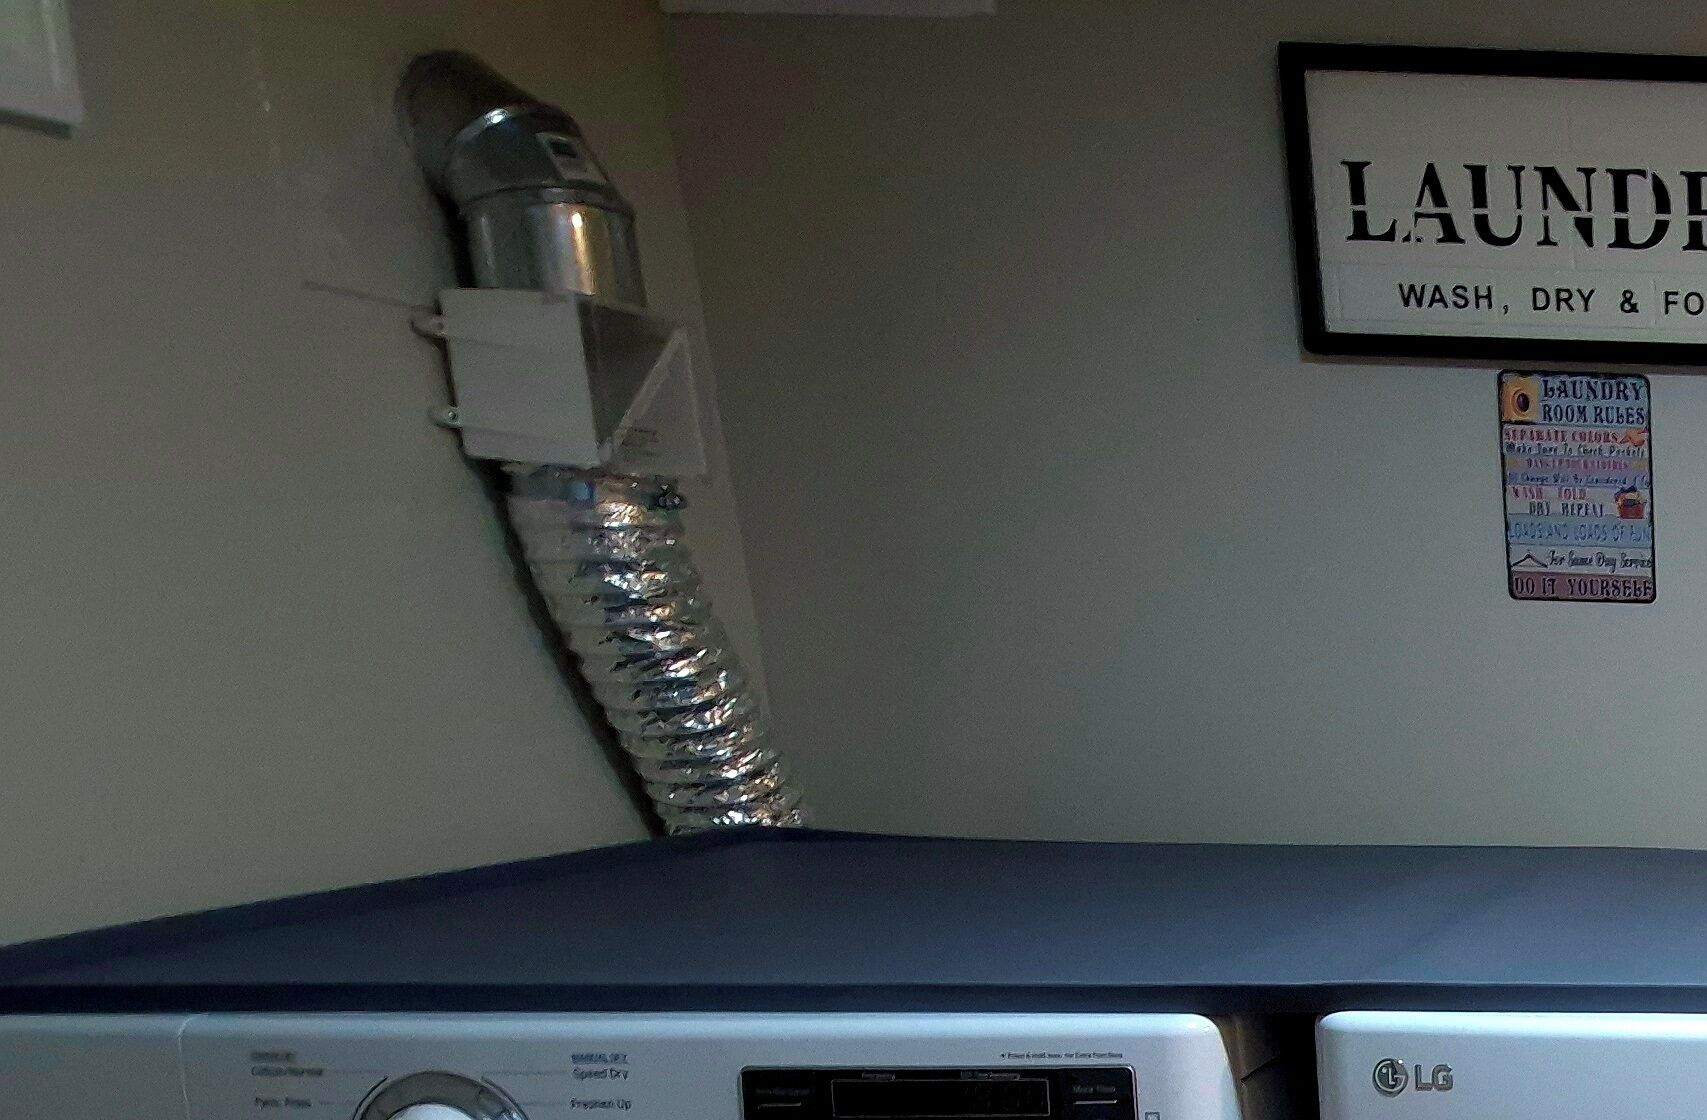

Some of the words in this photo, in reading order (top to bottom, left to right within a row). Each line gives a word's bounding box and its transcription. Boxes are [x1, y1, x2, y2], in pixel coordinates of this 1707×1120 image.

[1399, 283, 1510, 315] WASH,
[1532, 287, 1596, 313] DRY
[1620, 289, 1640, 313] &
[1542, 379, 1642, 401] LAUNDRY
[1542, 404, 1588, 423] ROOM
[1594, 405, 1645, 425] RULES
[1505, 429, 1567, 443] SEPARATE
[1529, 501, 1550, 516] DRY
[1514, 577, 1535, 595] DO
[1542, 577, 1556, 596] IT
[1567, 578, 1653, 598] YOURSELF
[1414, 1064, 1454, 1092] LG
